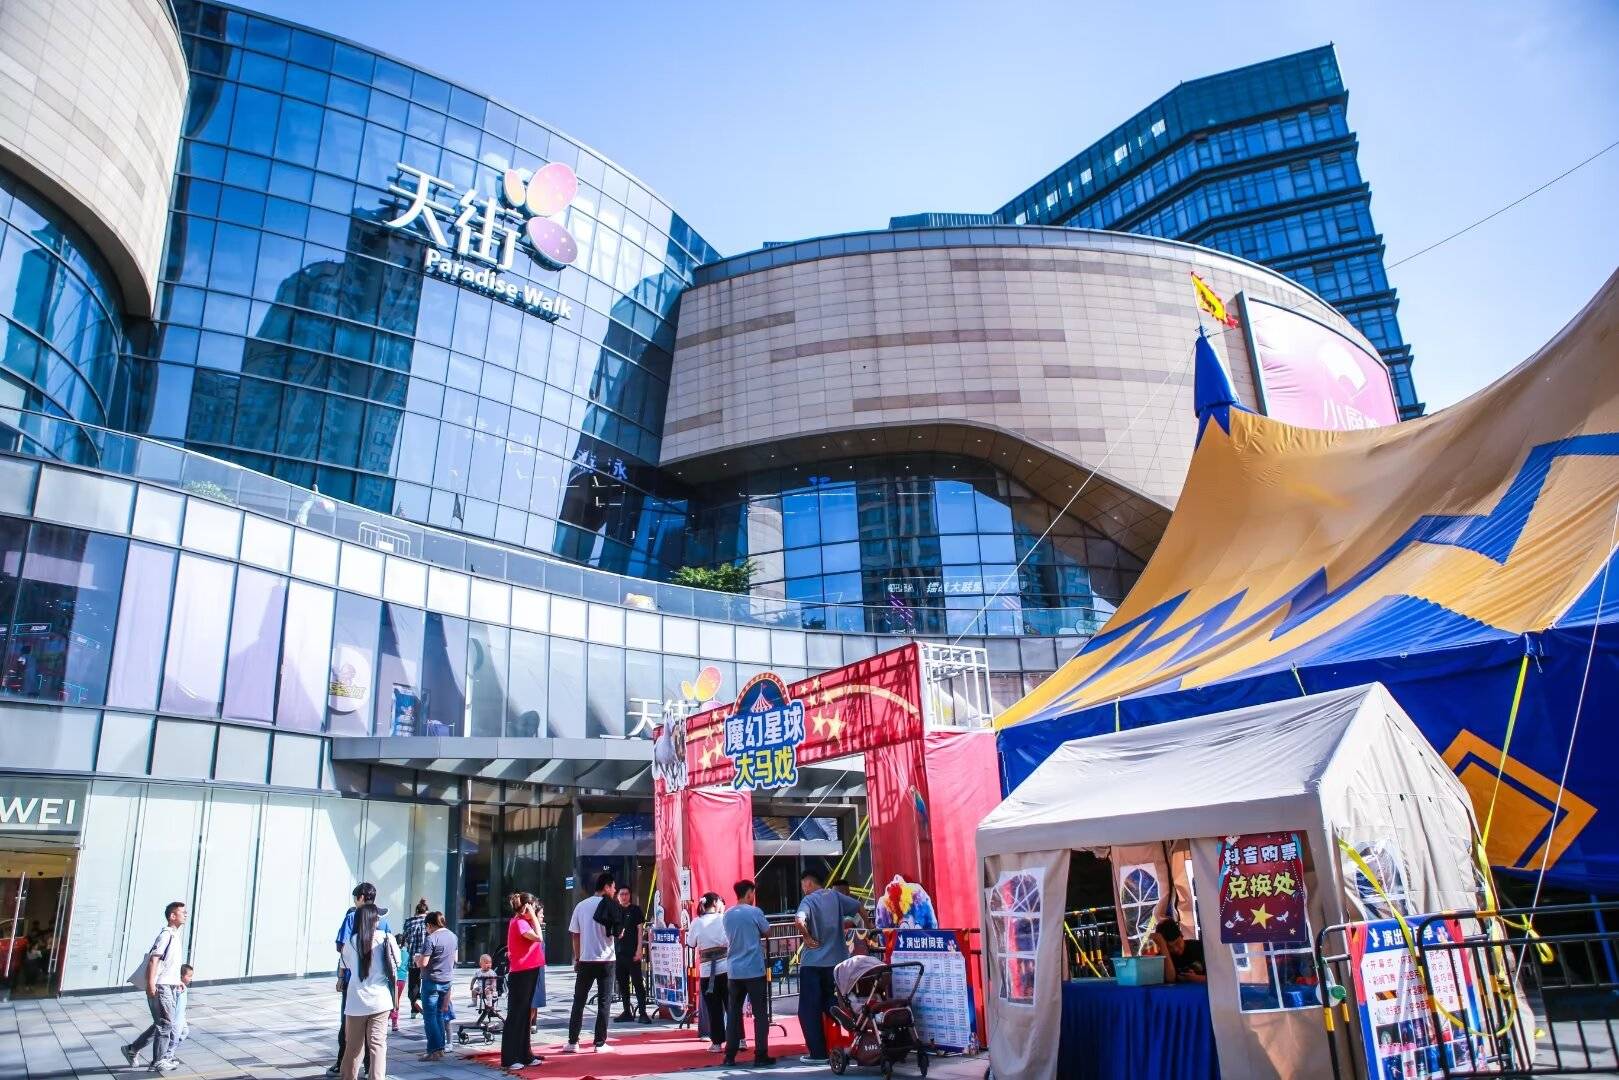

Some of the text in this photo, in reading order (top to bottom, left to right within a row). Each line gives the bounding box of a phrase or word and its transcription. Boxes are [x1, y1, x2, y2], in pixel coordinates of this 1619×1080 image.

[383, 162, 524, 270] 天街
[424, 247, 572, 321] Paradise Walk
[725, 703, 804, 752] 魔幻星球
[734, 747, 795, 789] 大马戏
[1224, 842, 1298, 865] 抖音购票
[1228, 872, 1296, 899] 兑换处
[906, 937, 944, 949] 演出时间表
